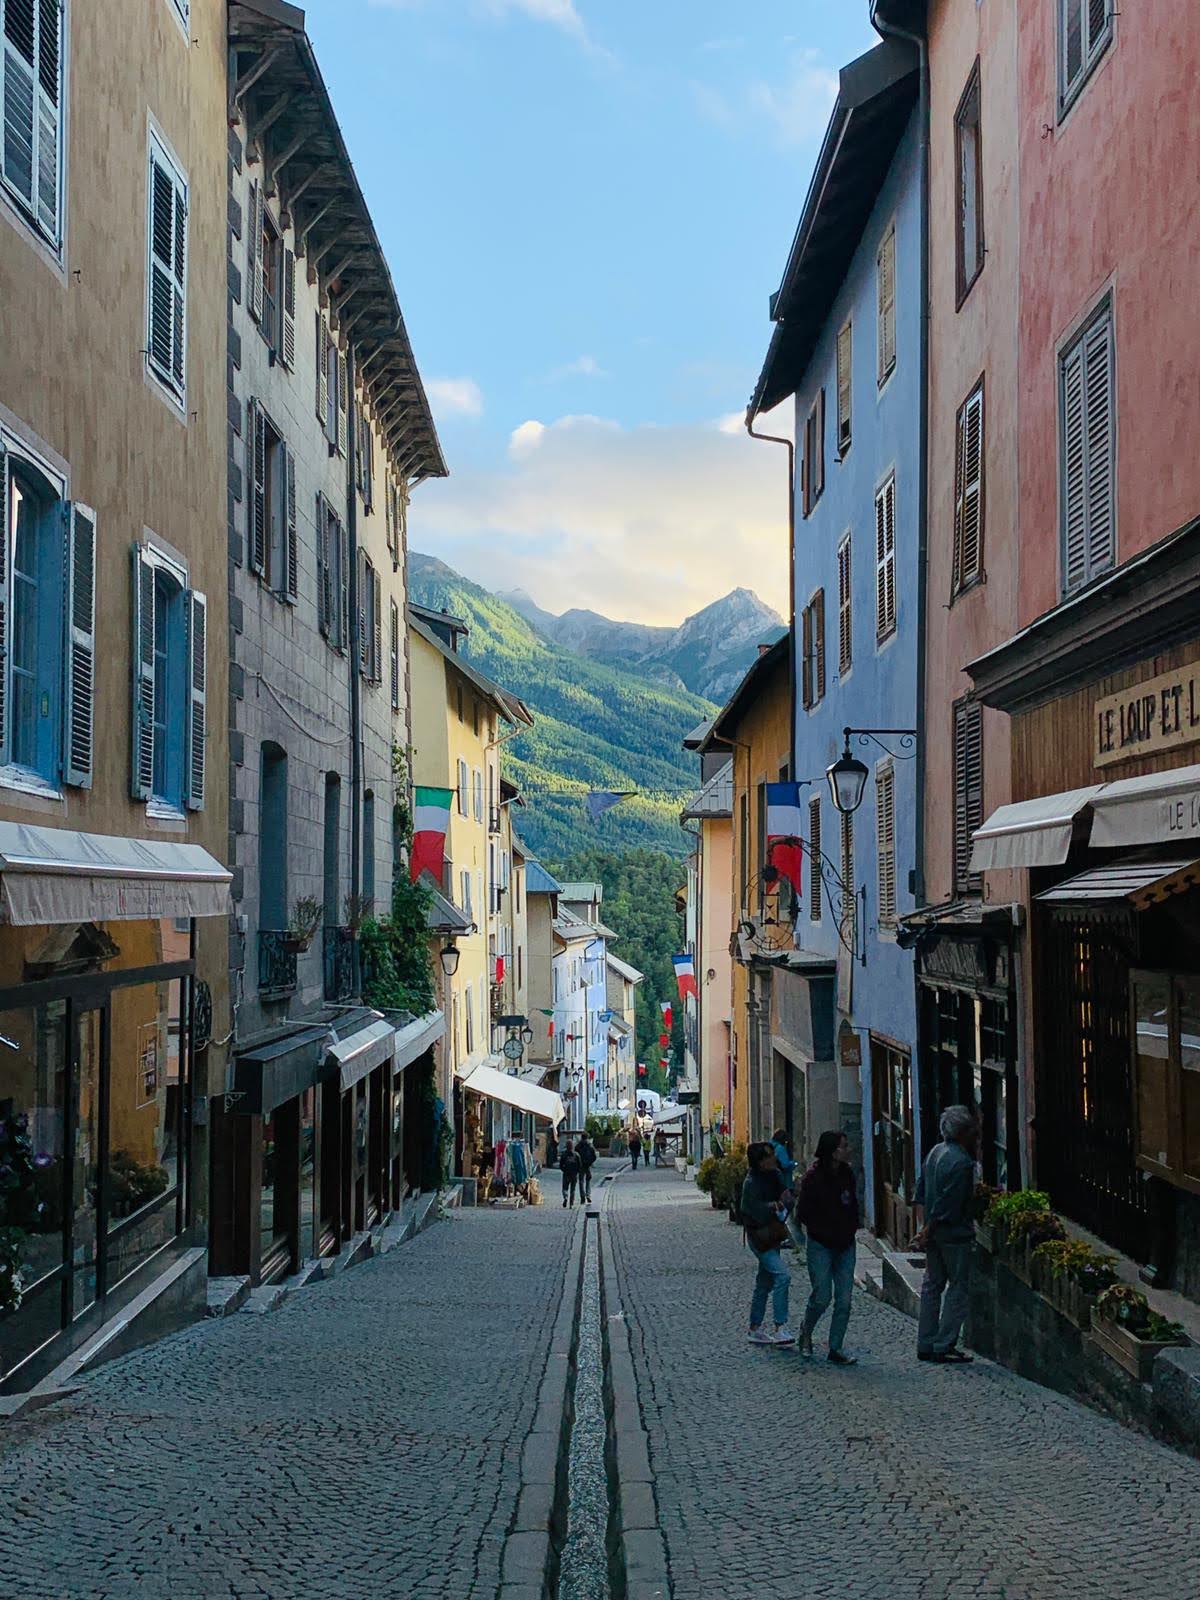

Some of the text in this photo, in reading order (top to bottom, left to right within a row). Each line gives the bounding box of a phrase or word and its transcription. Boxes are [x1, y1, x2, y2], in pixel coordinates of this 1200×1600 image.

[1099, 709, 1115, 754] LE
[1120, 694, 1156, 748] LOUP
[1161, 684, 1184, 736] ET
[1169, 801, 1184, 831] LE
